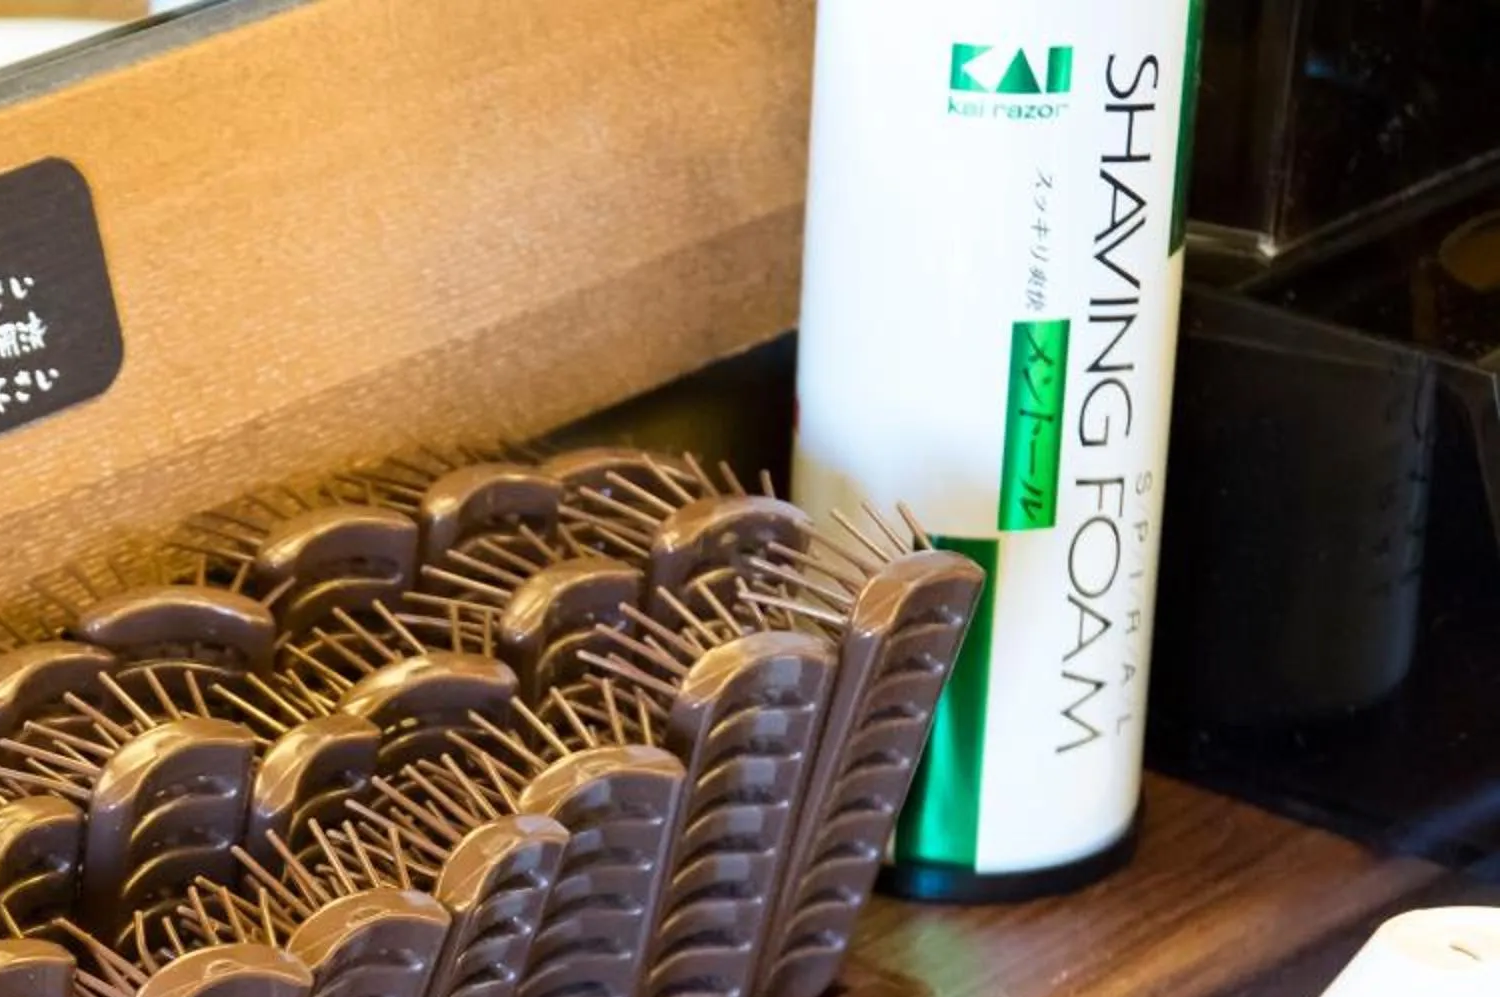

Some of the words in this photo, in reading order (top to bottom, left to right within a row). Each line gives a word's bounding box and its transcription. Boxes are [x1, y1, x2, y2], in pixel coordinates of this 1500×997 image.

[950, 43, 1073, 94] KAI
[1078, 54, 1159, 448] SHAVING
[1018, 326, 1053, 523] メントール
[1055, 477, 1125, 754] FOAM
